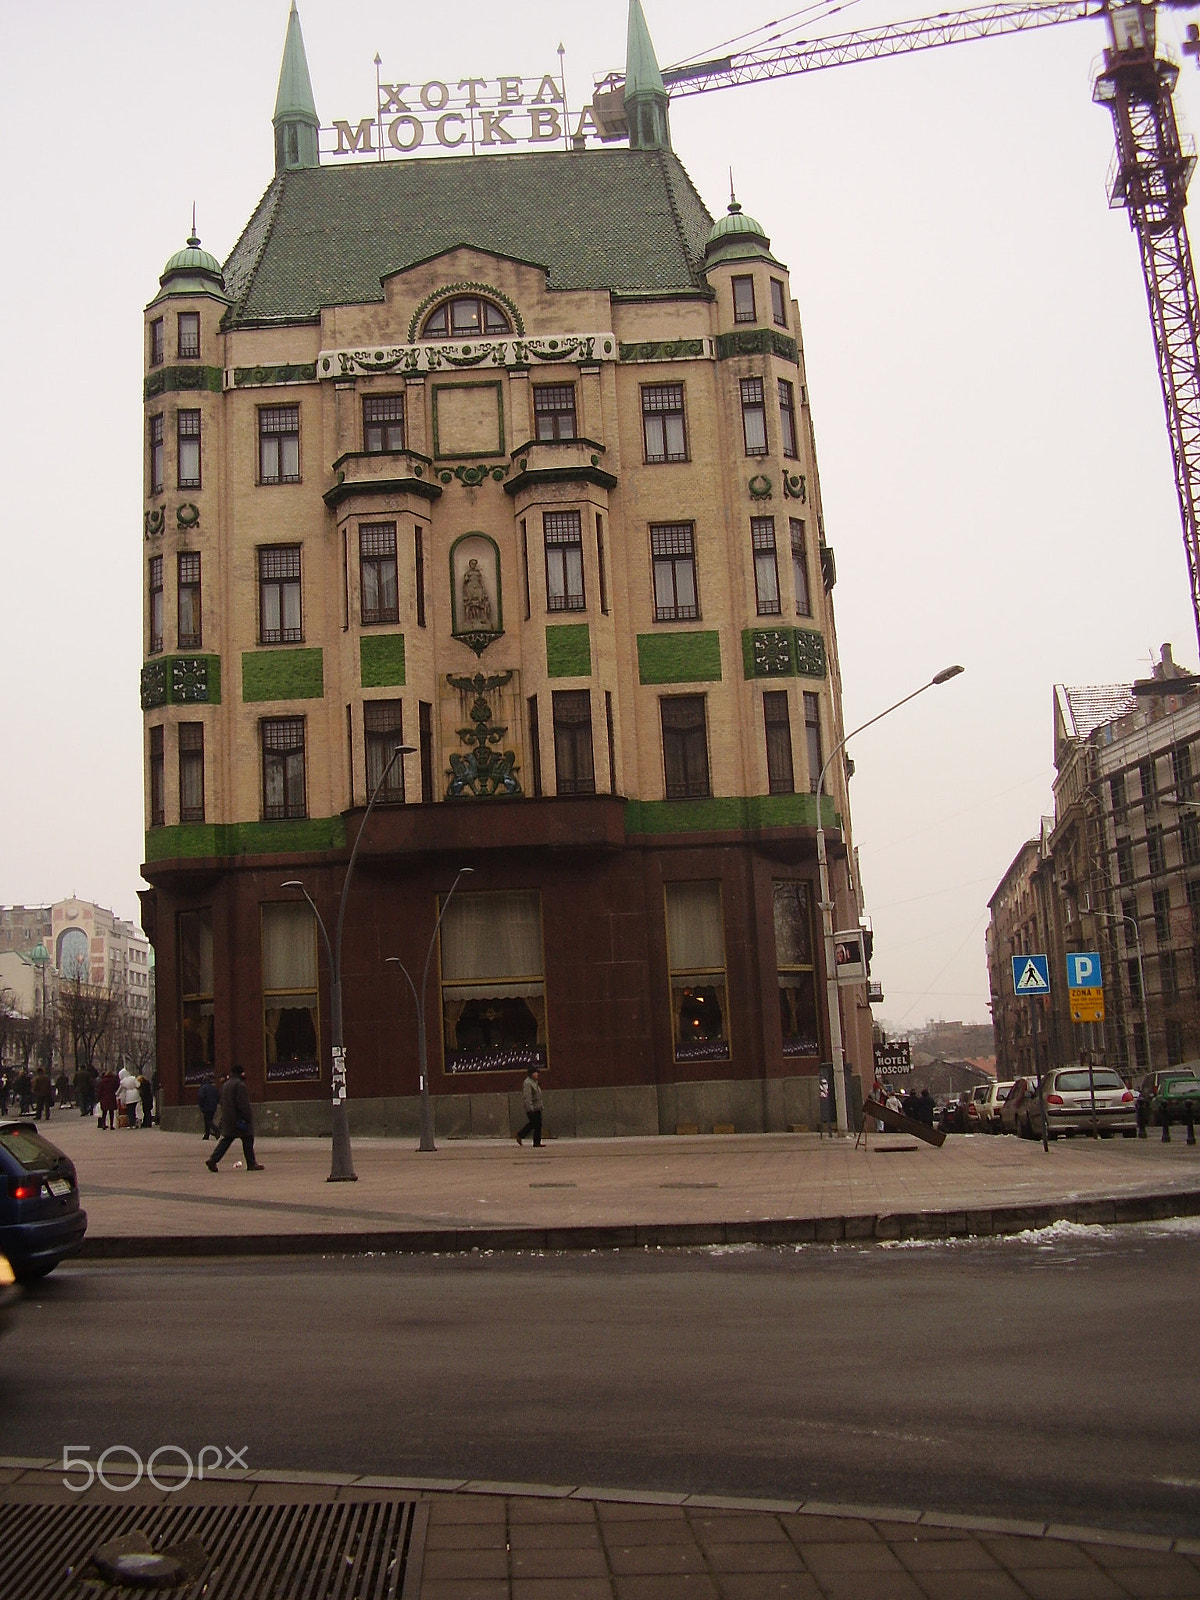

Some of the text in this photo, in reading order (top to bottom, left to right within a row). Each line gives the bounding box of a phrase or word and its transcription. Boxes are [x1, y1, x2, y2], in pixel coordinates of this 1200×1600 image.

[379, 75, 564, 113] ХОТЕЛ
[332, 105, 608, 154] МОСКВА
[1075, 957, 1093, 984] P
[1072, 989, 1092, 997] ZONA
[875, 1065, 910, 1075] MOSCOW
[877, 1056, 908, 1066] HOTEL
